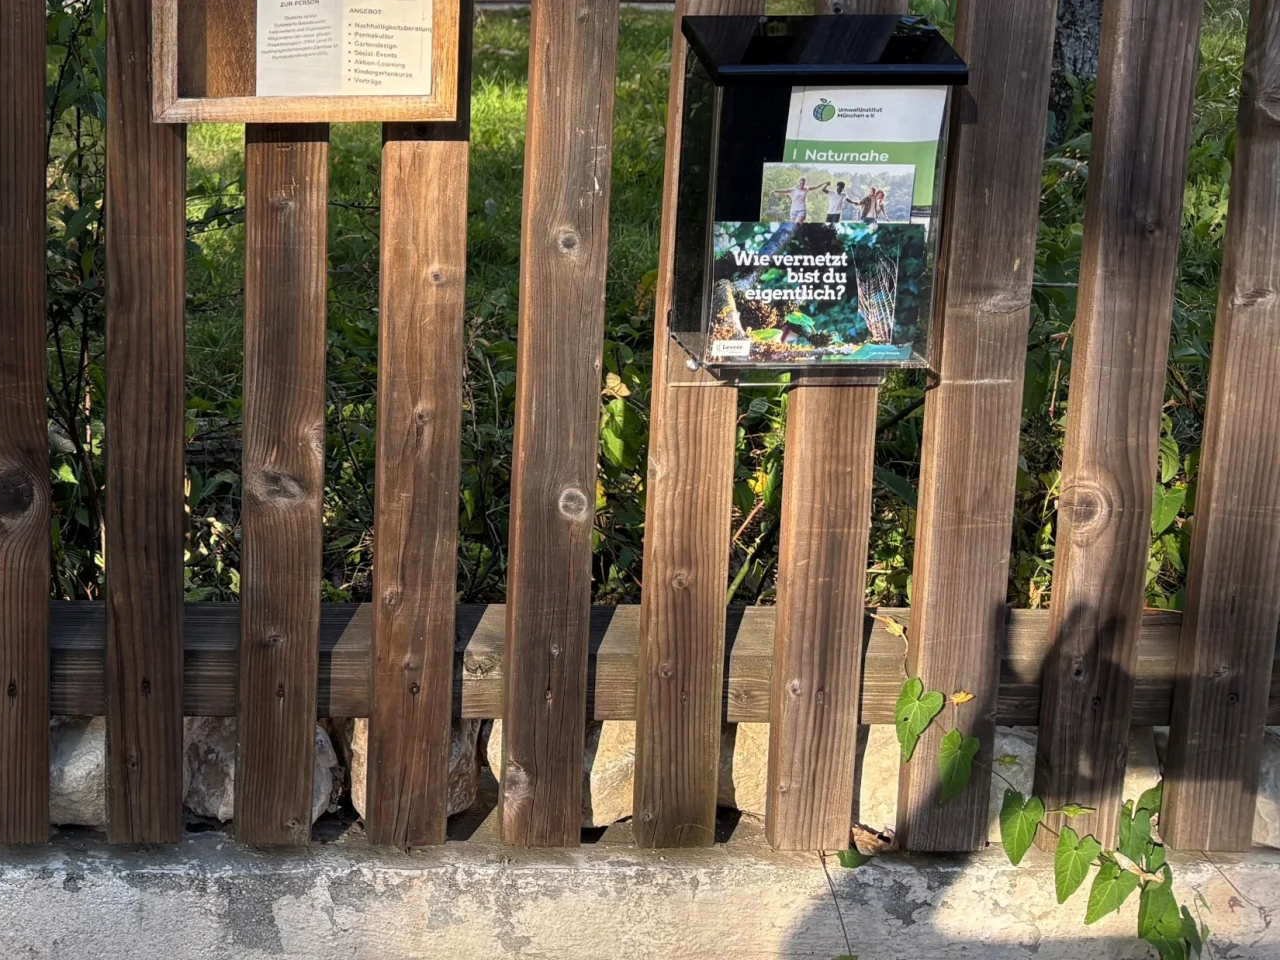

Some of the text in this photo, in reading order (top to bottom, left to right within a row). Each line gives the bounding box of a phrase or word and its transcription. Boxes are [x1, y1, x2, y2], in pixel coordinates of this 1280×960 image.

[354, 31, 394, 40] Permakultur
[354, 40, 397, 50] Gartendesign
[354, 77, 382, 86] Vorträge
[804, 148, 889, 162] Naturnahe
[733, 250, 848, 267] Wie vernetzt
[786, 268, 848, 283] bist du
[745, 285, 846, 304] eigentlich?
